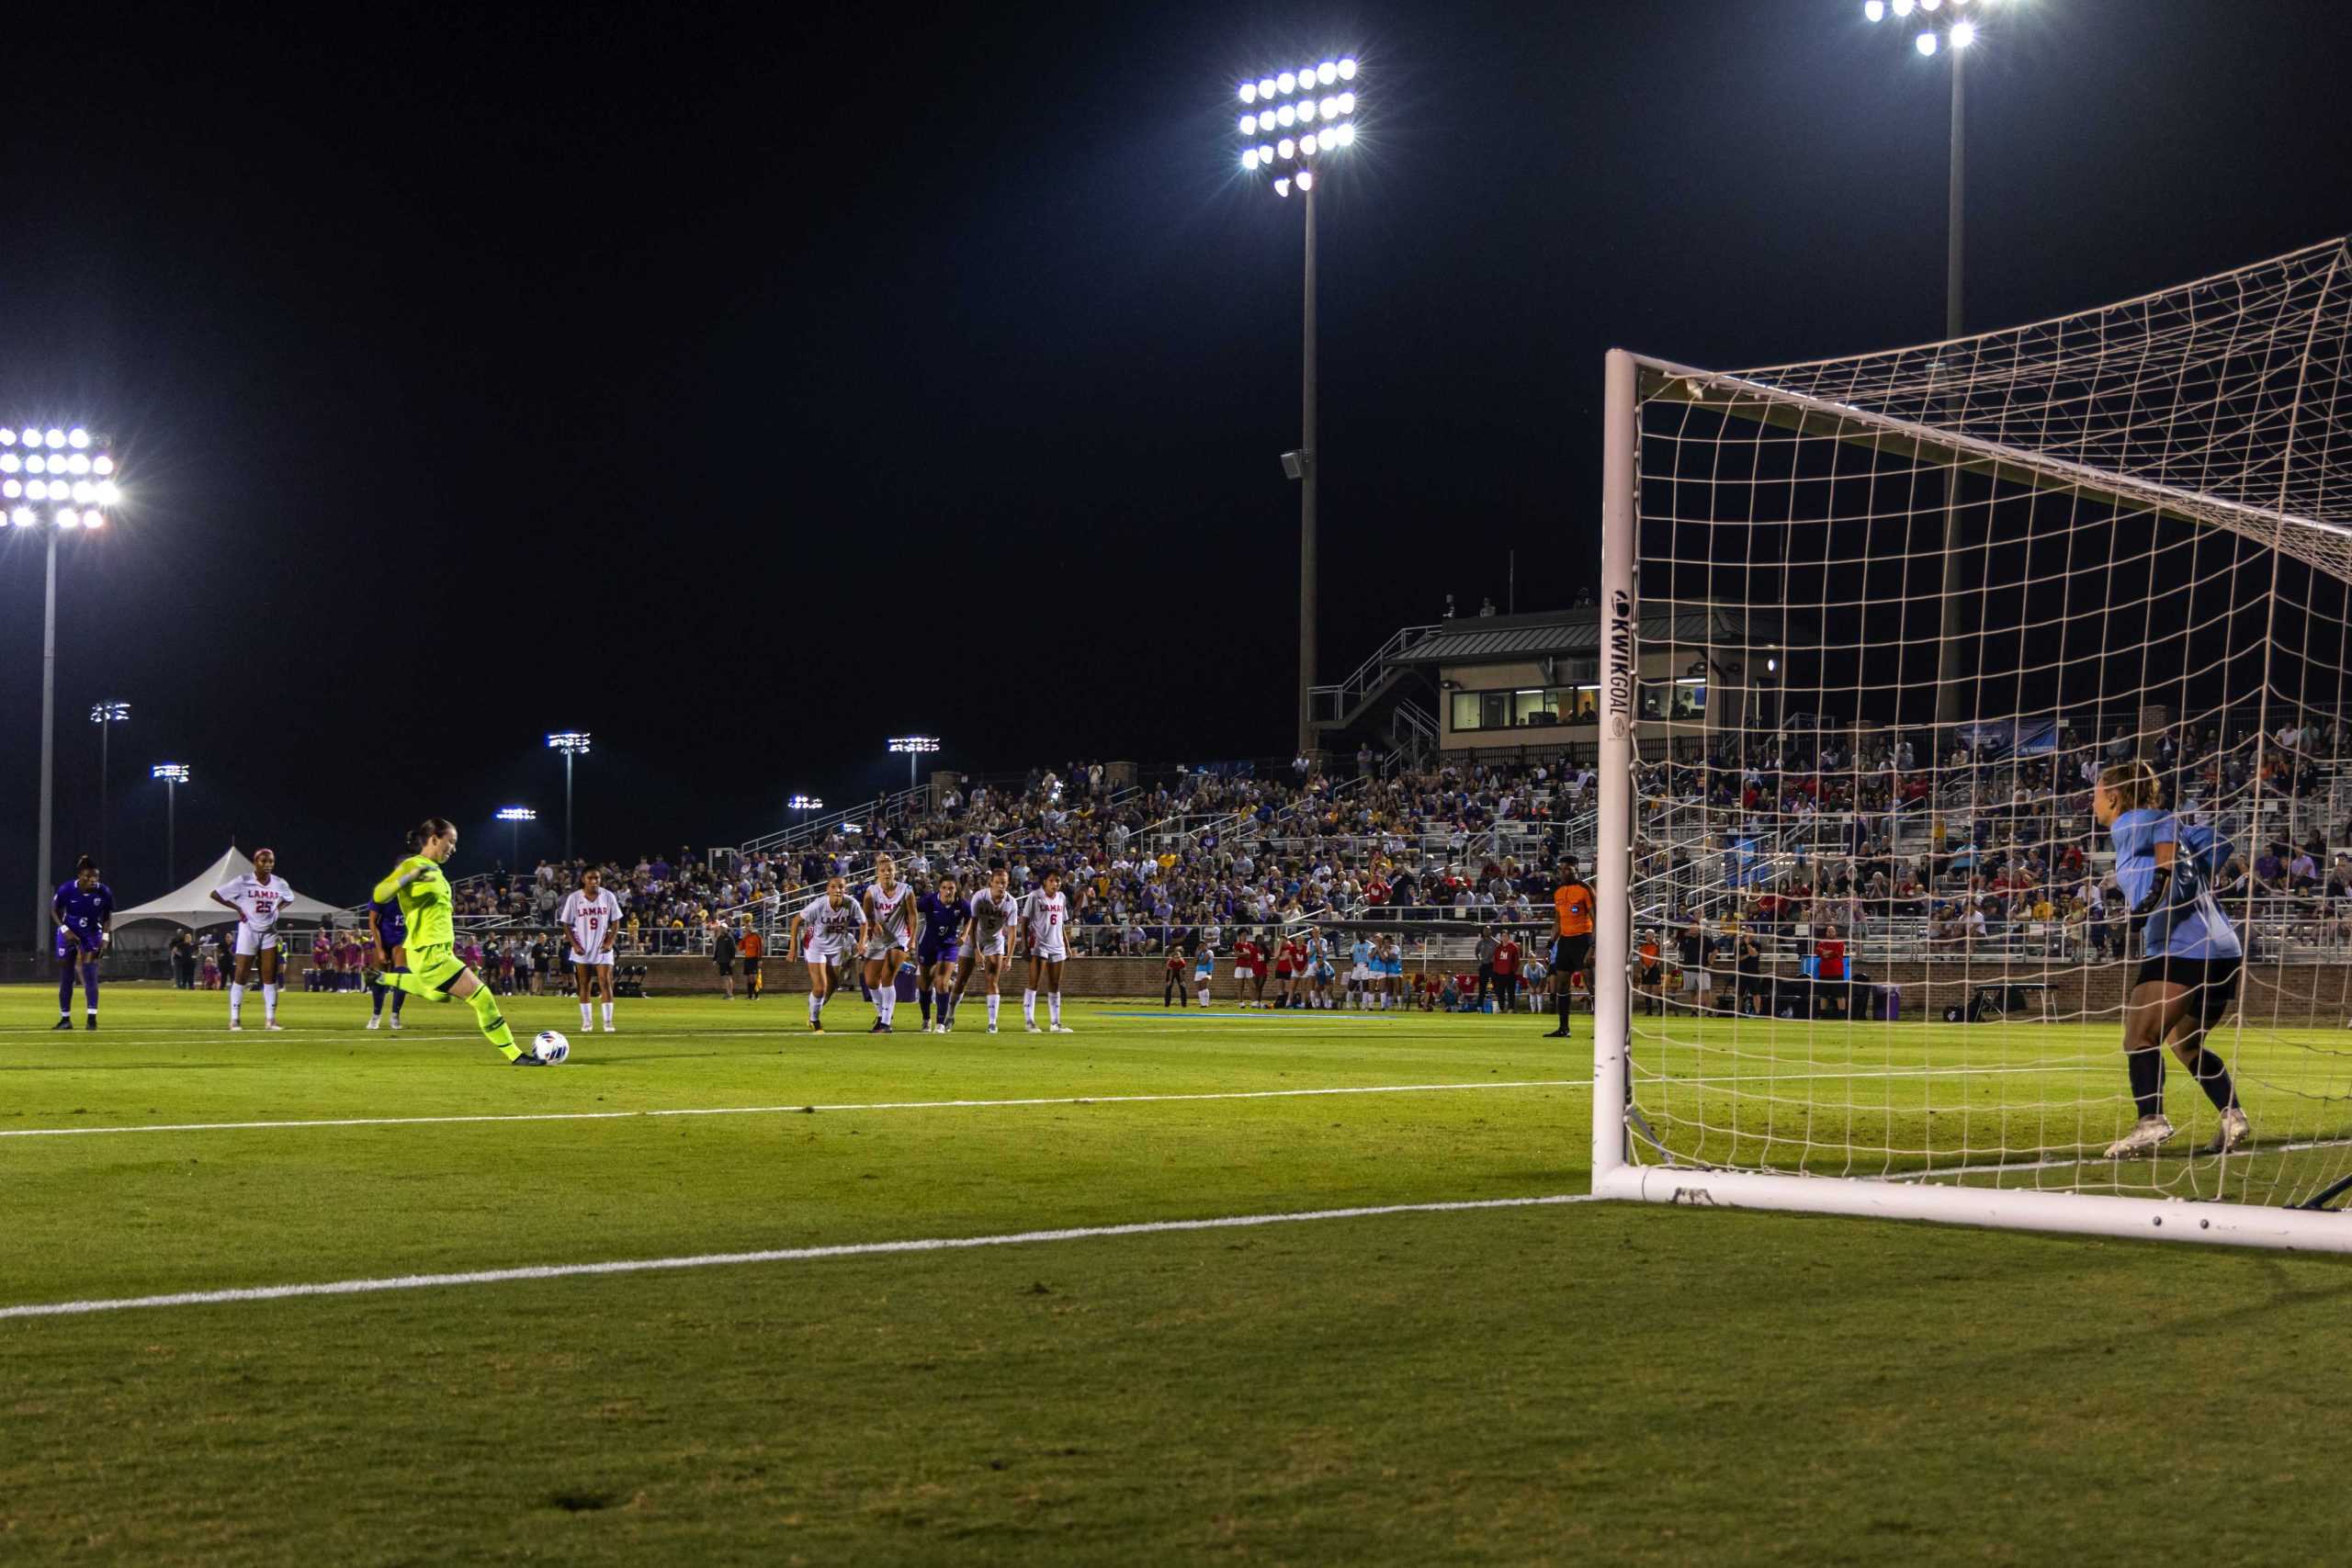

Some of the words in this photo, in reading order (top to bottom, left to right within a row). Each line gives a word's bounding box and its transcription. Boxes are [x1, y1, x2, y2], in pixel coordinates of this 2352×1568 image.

[255, 900, 273, 913] 25
[578, 907, 607, 918] LAMAR
[590, 918, 598, 931] 9
[1049, 914, 1057, 926] 6
